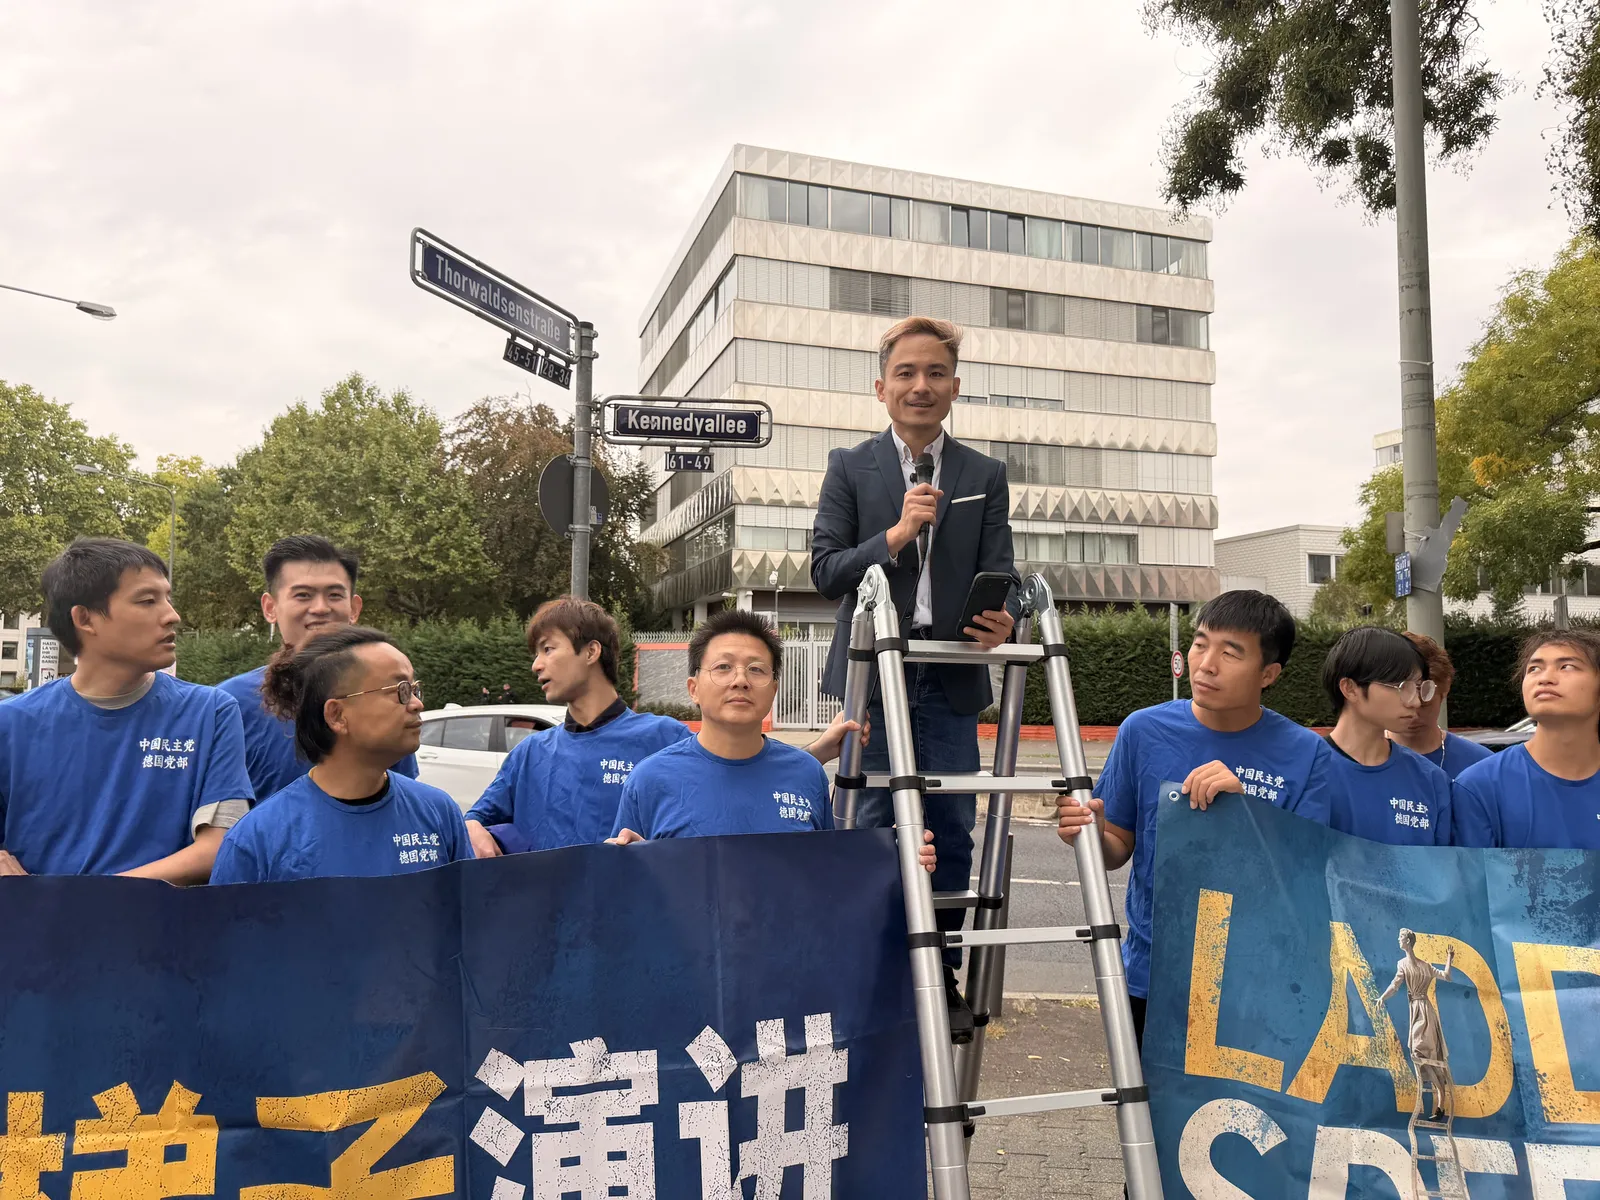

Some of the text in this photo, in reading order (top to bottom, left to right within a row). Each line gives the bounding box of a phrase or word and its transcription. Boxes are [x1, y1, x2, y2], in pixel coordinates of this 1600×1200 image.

[435, 253, 561, 341] Thorwaldsenstraße
[507, 343, 537, 371] 45-51
[542, 360, 570, 386] 28-36
[627, 409, 747, 436] Kennedyallee
[669, 454, 711, 470] 61-49
[139, 737, 195, 752] 中国民主党
[142, 754, 188, 770] 德国党部
[600, 758, 635, 772] 中国民主
[602, 772, 628, 786] 德国
[1235, 765, 1285, 789] 中国民主党
[392, 832, 440, 847] 中国民主党
[398, 848, 438, 864] 德国党部
